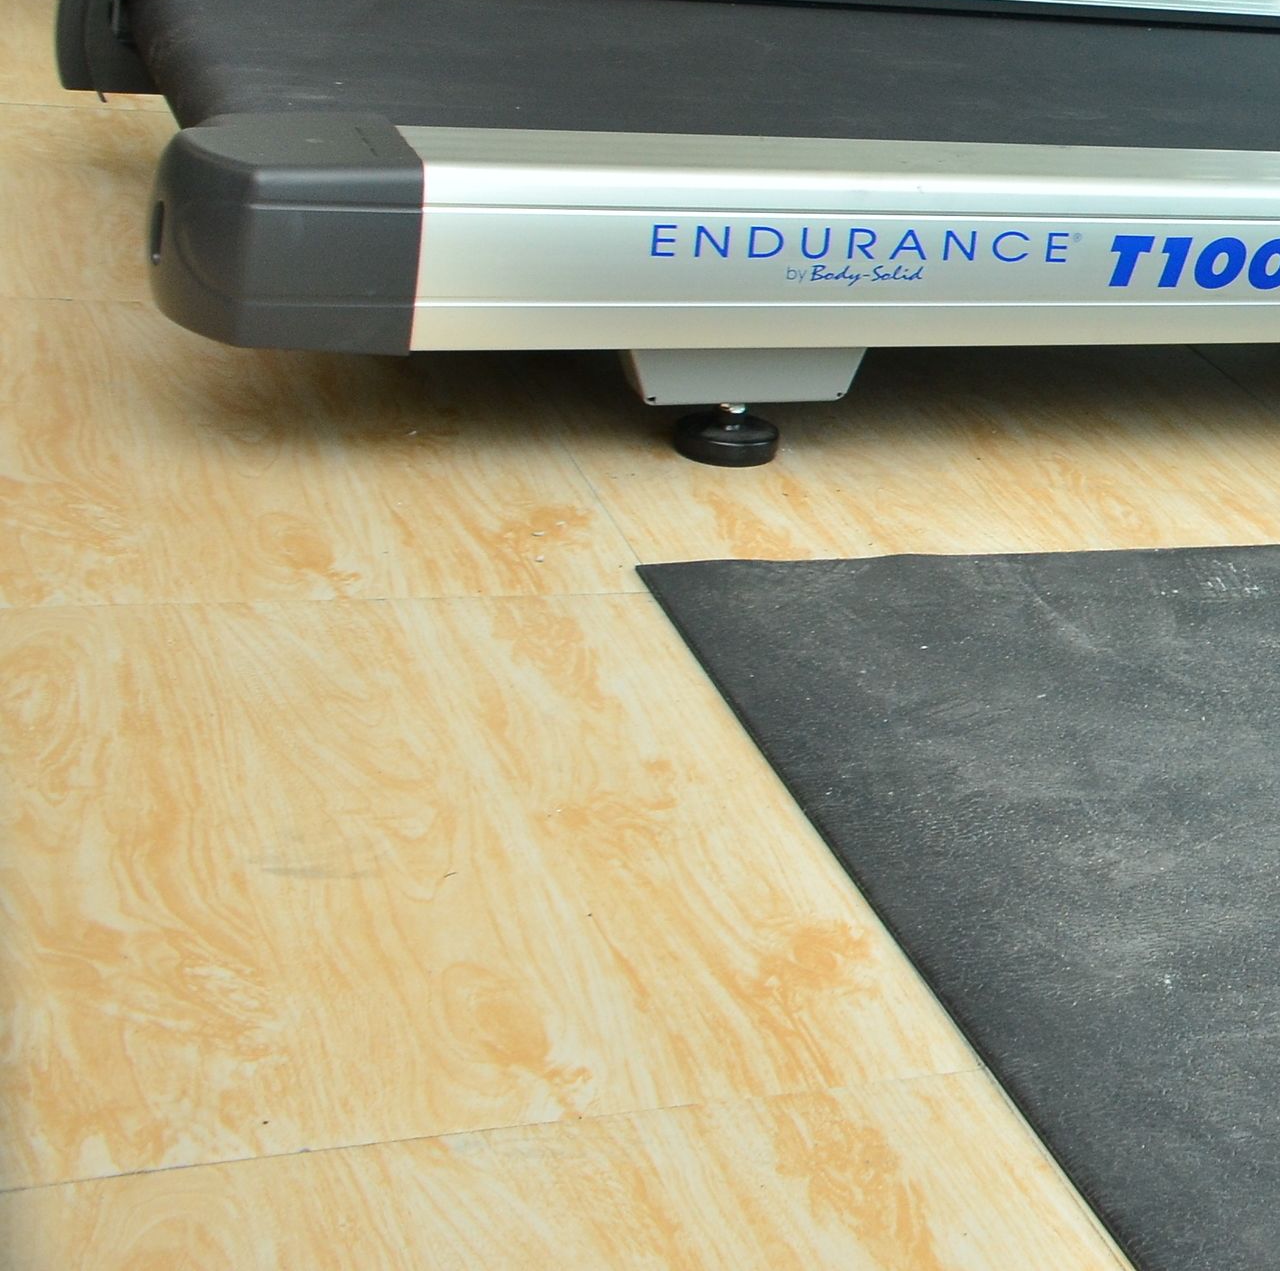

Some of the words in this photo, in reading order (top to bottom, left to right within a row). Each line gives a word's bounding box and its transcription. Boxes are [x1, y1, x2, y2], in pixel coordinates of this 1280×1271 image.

[650, 224, 1070, 263] ENDURANCE
[786, 266, 806, 283] by
[809, 265, 923, 287] Body-Solid
